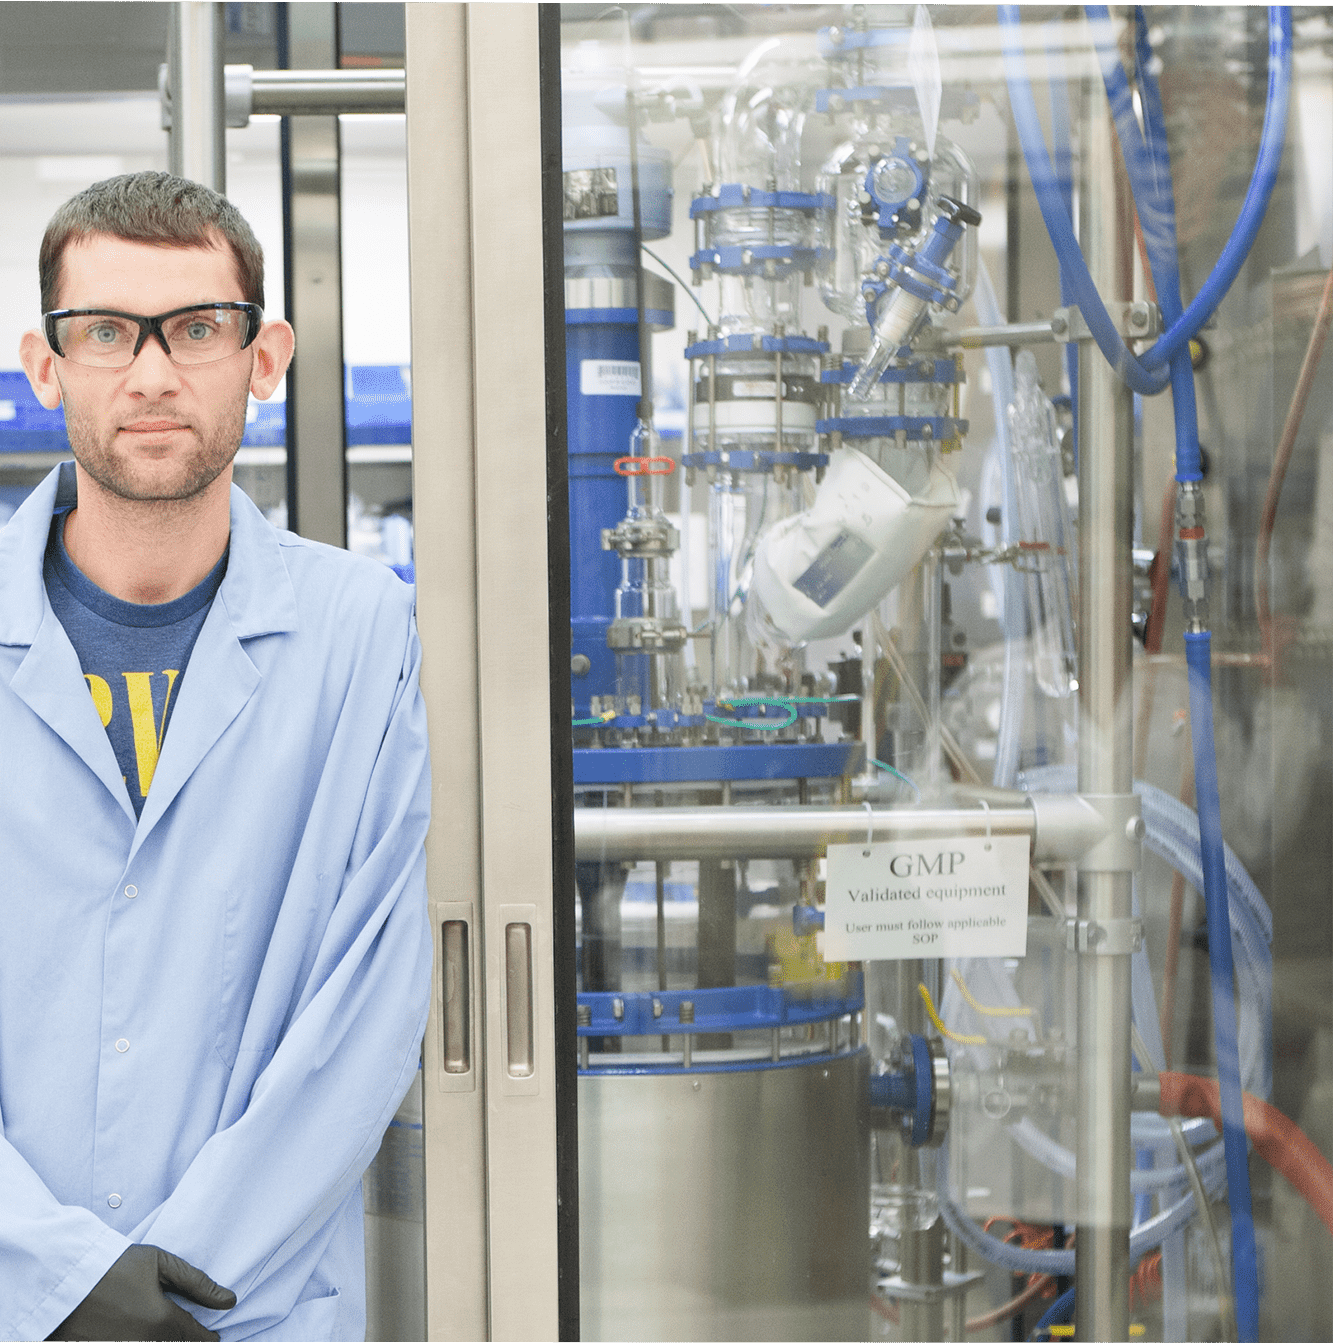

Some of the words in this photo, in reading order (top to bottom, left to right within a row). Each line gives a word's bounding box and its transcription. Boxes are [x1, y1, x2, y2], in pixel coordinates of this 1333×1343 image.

[889, 851, 966, 878] GMP
[848, 886, 921, 903] Validated
[926, 883, 1006, 901] equipment
[845, 922, 873, 934] User
[875, 921, 904, 932] must
[907, 918, 944, 931] follow
[947, 915, 1007, 931] applicable
[912, 934, 939, 945] SOP
